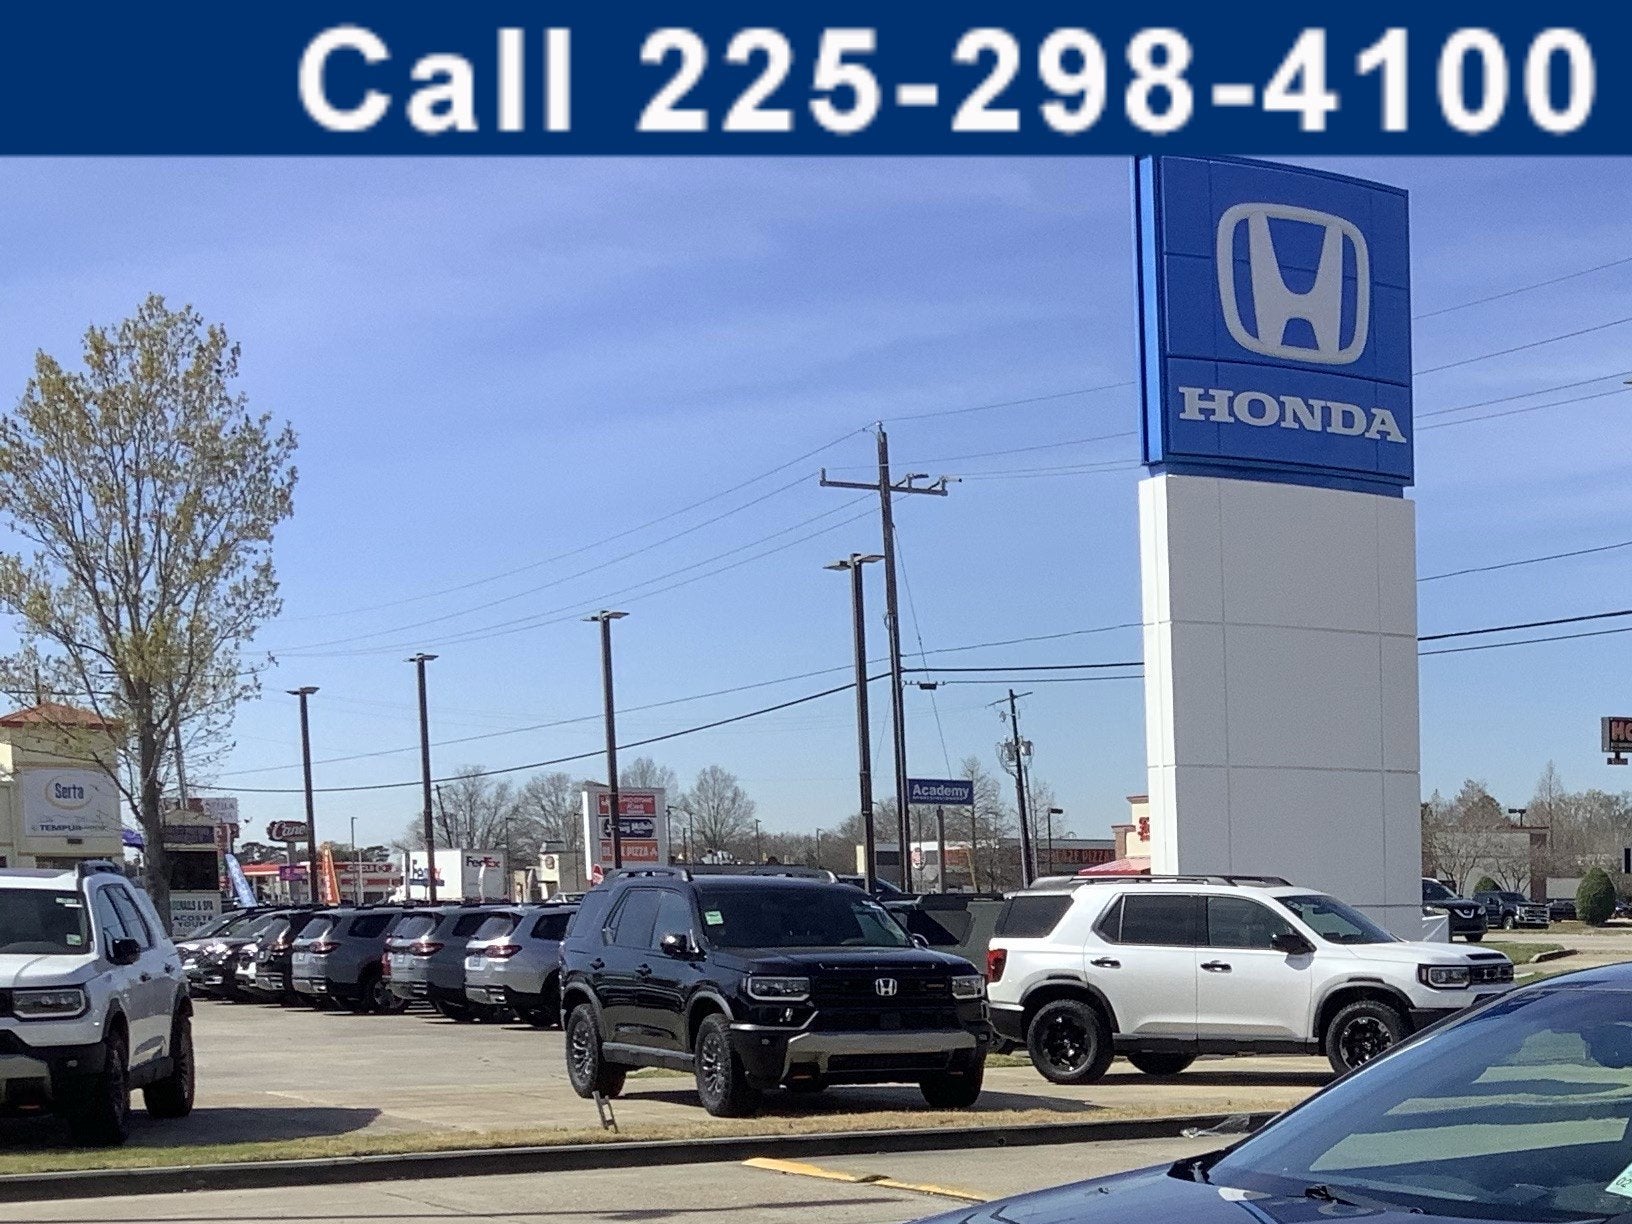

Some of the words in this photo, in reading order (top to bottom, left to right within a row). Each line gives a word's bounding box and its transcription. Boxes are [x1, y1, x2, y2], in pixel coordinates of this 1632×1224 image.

[1178, 387, 1407, 443] HONDA
[54, 782, 85, 800] Serta
[912, 783, 970, 798] Academy
[272, 821, 306, 841] Cane
[465, 855, 500, 868] FedEx
[1615, 1177, 1632, 1188] 02
